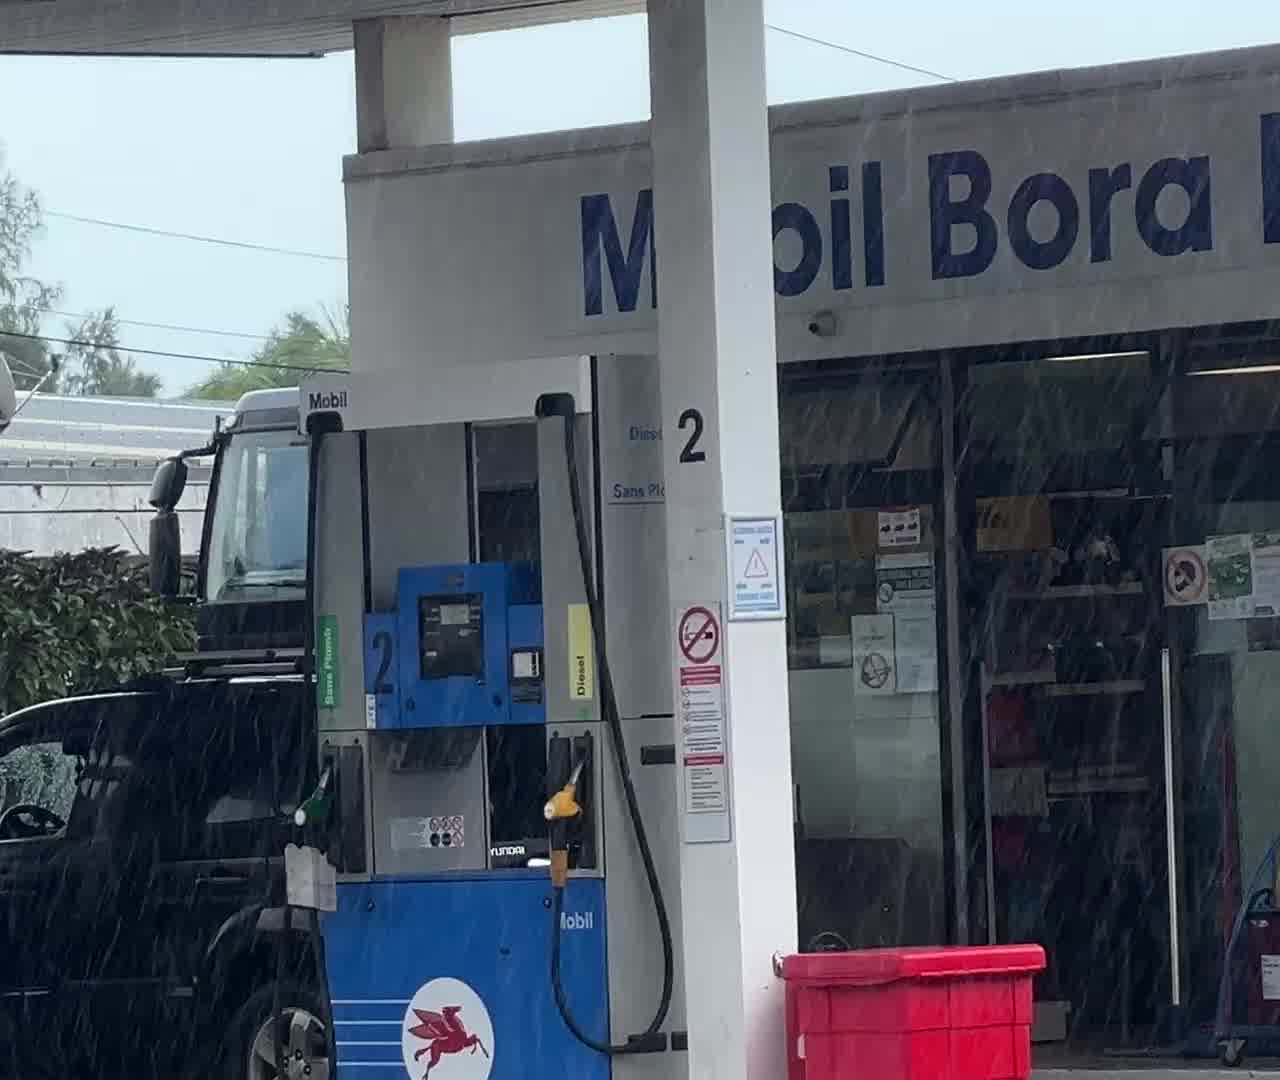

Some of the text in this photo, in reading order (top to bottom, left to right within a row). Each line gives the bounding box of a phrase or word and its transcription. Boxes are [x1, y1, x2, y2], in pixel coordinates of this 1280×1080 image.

[580, 161, 886, 317] Mil
[927, 148, 1214, 280] Bora
[309, 390, 347, 410] Mobil
[678, 408, 706, 463] 2
[372, 631, 394, 694] 2
[576, 655, 586, 697] Diesel
[488, 846, 526, 857] YUNDAI
